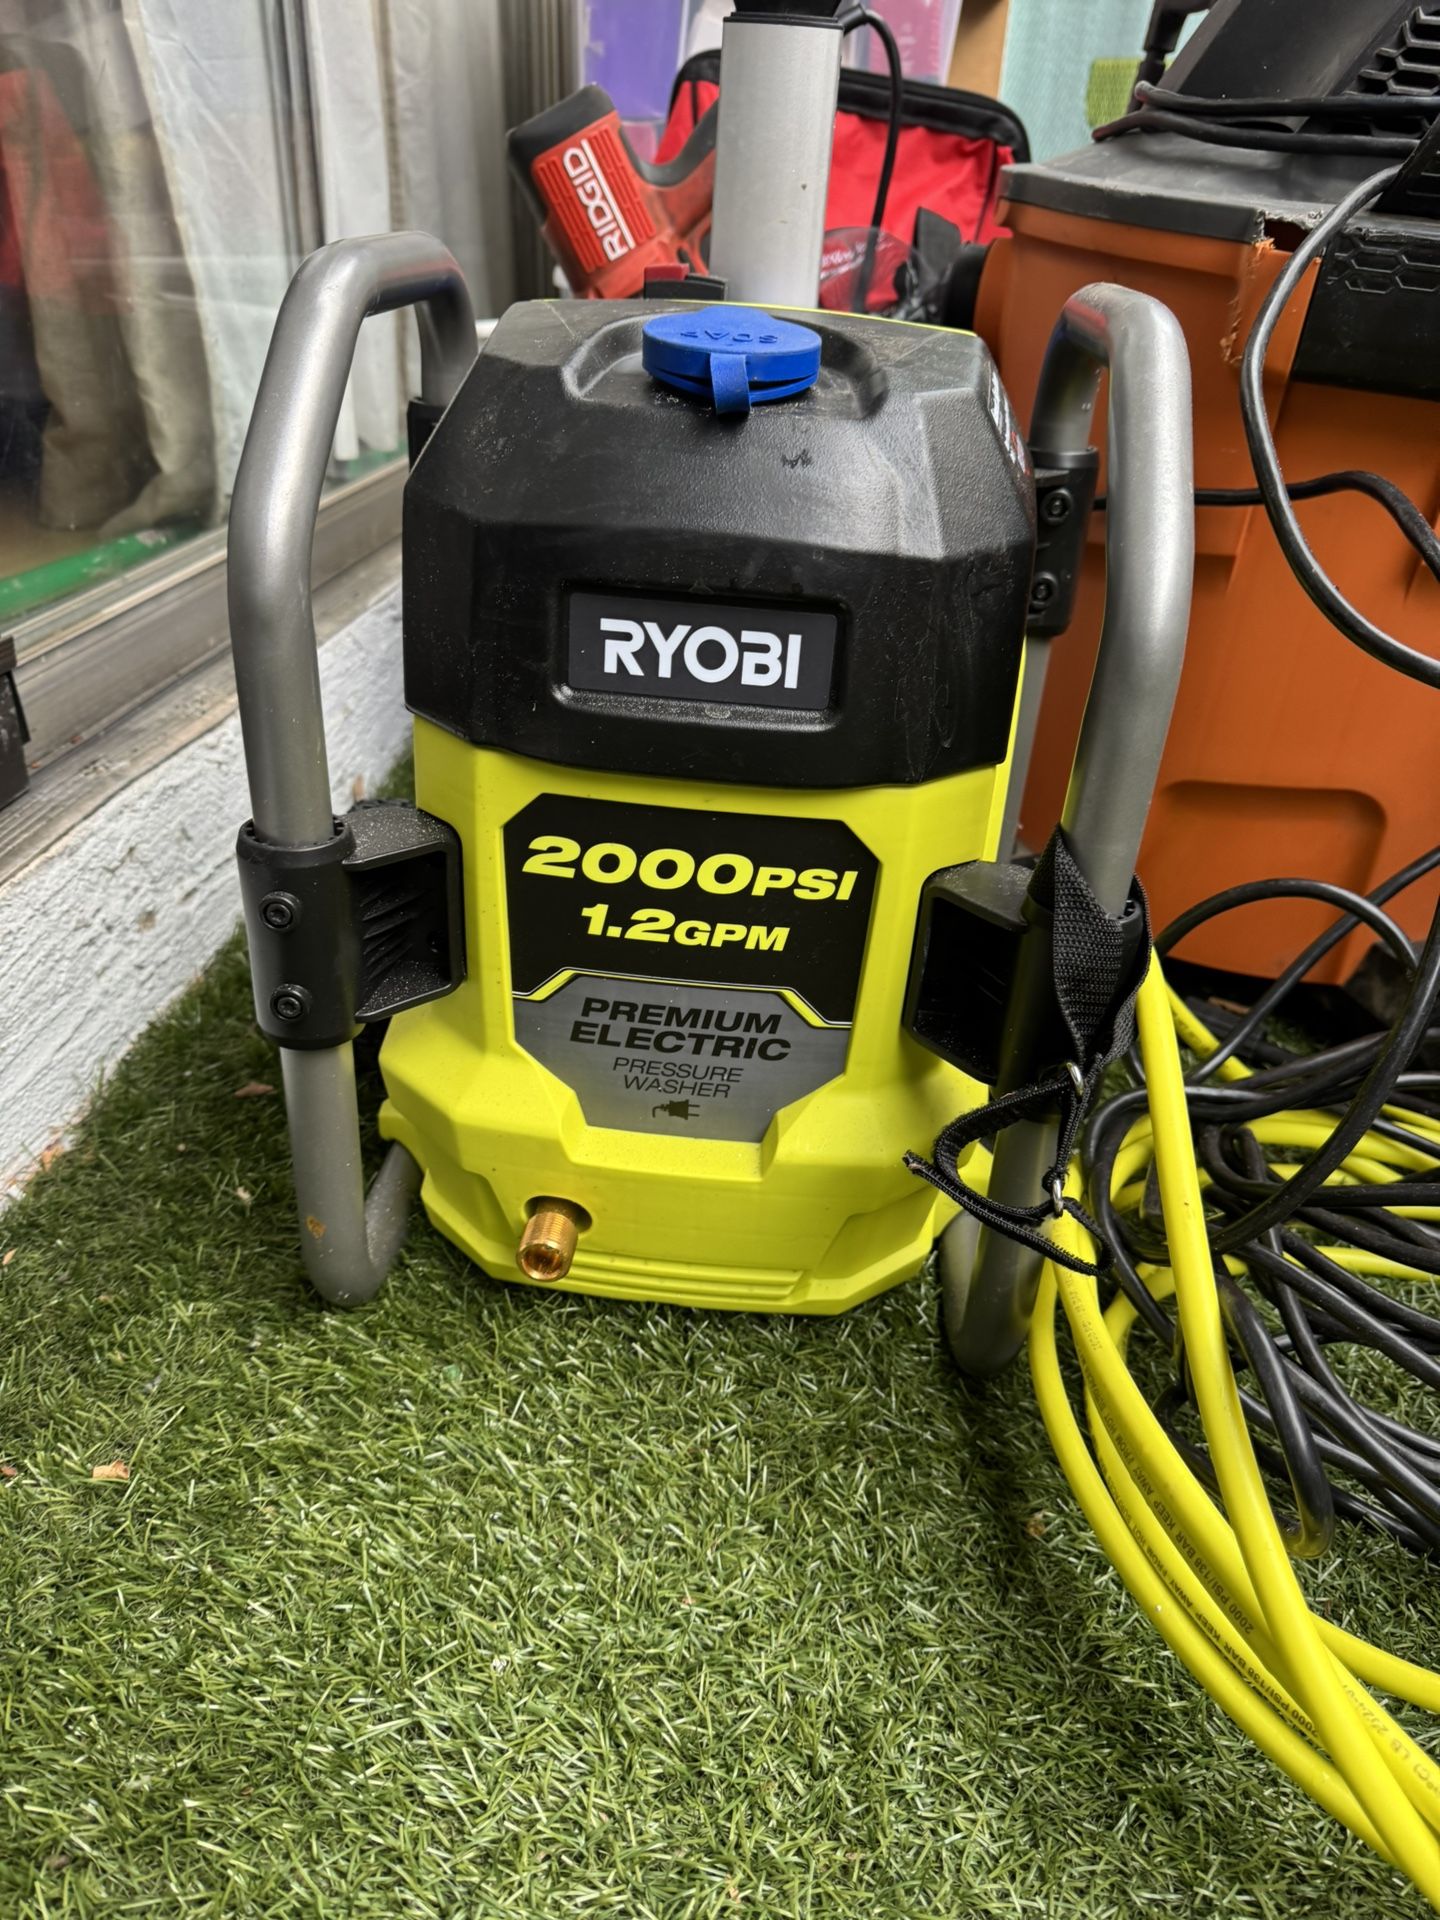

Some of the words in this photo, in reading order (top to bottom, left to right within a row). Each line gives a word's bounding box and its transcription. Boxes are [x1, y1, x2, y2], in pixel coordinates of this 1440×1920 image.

[563, 147, 629, 261] RIDGID
[680, 327, 779, 344] SOAP
[600, 618, 802, 689] RYOBI
[581, 997, 782, 1034] PREMIUM
[570, 1021, 791, 1061] ELECTRIC
[613, 1057, 744, 1082] PRESSURE
[624, 1075, 731, 1098] WASHER
[1103, 1413, 1118, 1434] HOT
[1115, 1435, 1135, 1465] FROM
[1132, 1467, 1154, 1496] AWAY
[1153, 1500, 1176, 1530] KEEP
[1132, 1525, 1147, 1545] HOT
[1175, 1531, 1196, 1560] BAR
[1146, 1546, 1168, 1577] FROM
[1169, 1579, 1193, 1609] AWAY
[1194, 1557, 1231, 1605] PSI/138
[1195, 1611, 1220, 1641] KEEP
[1229, 1603, 1255, 1635] 2000
[1223, 1642, 1247, 1667] BAR
[1247, 1667, 1290, 1709] PSI/138
[1291, 1708, 1319, 1738] 2000
